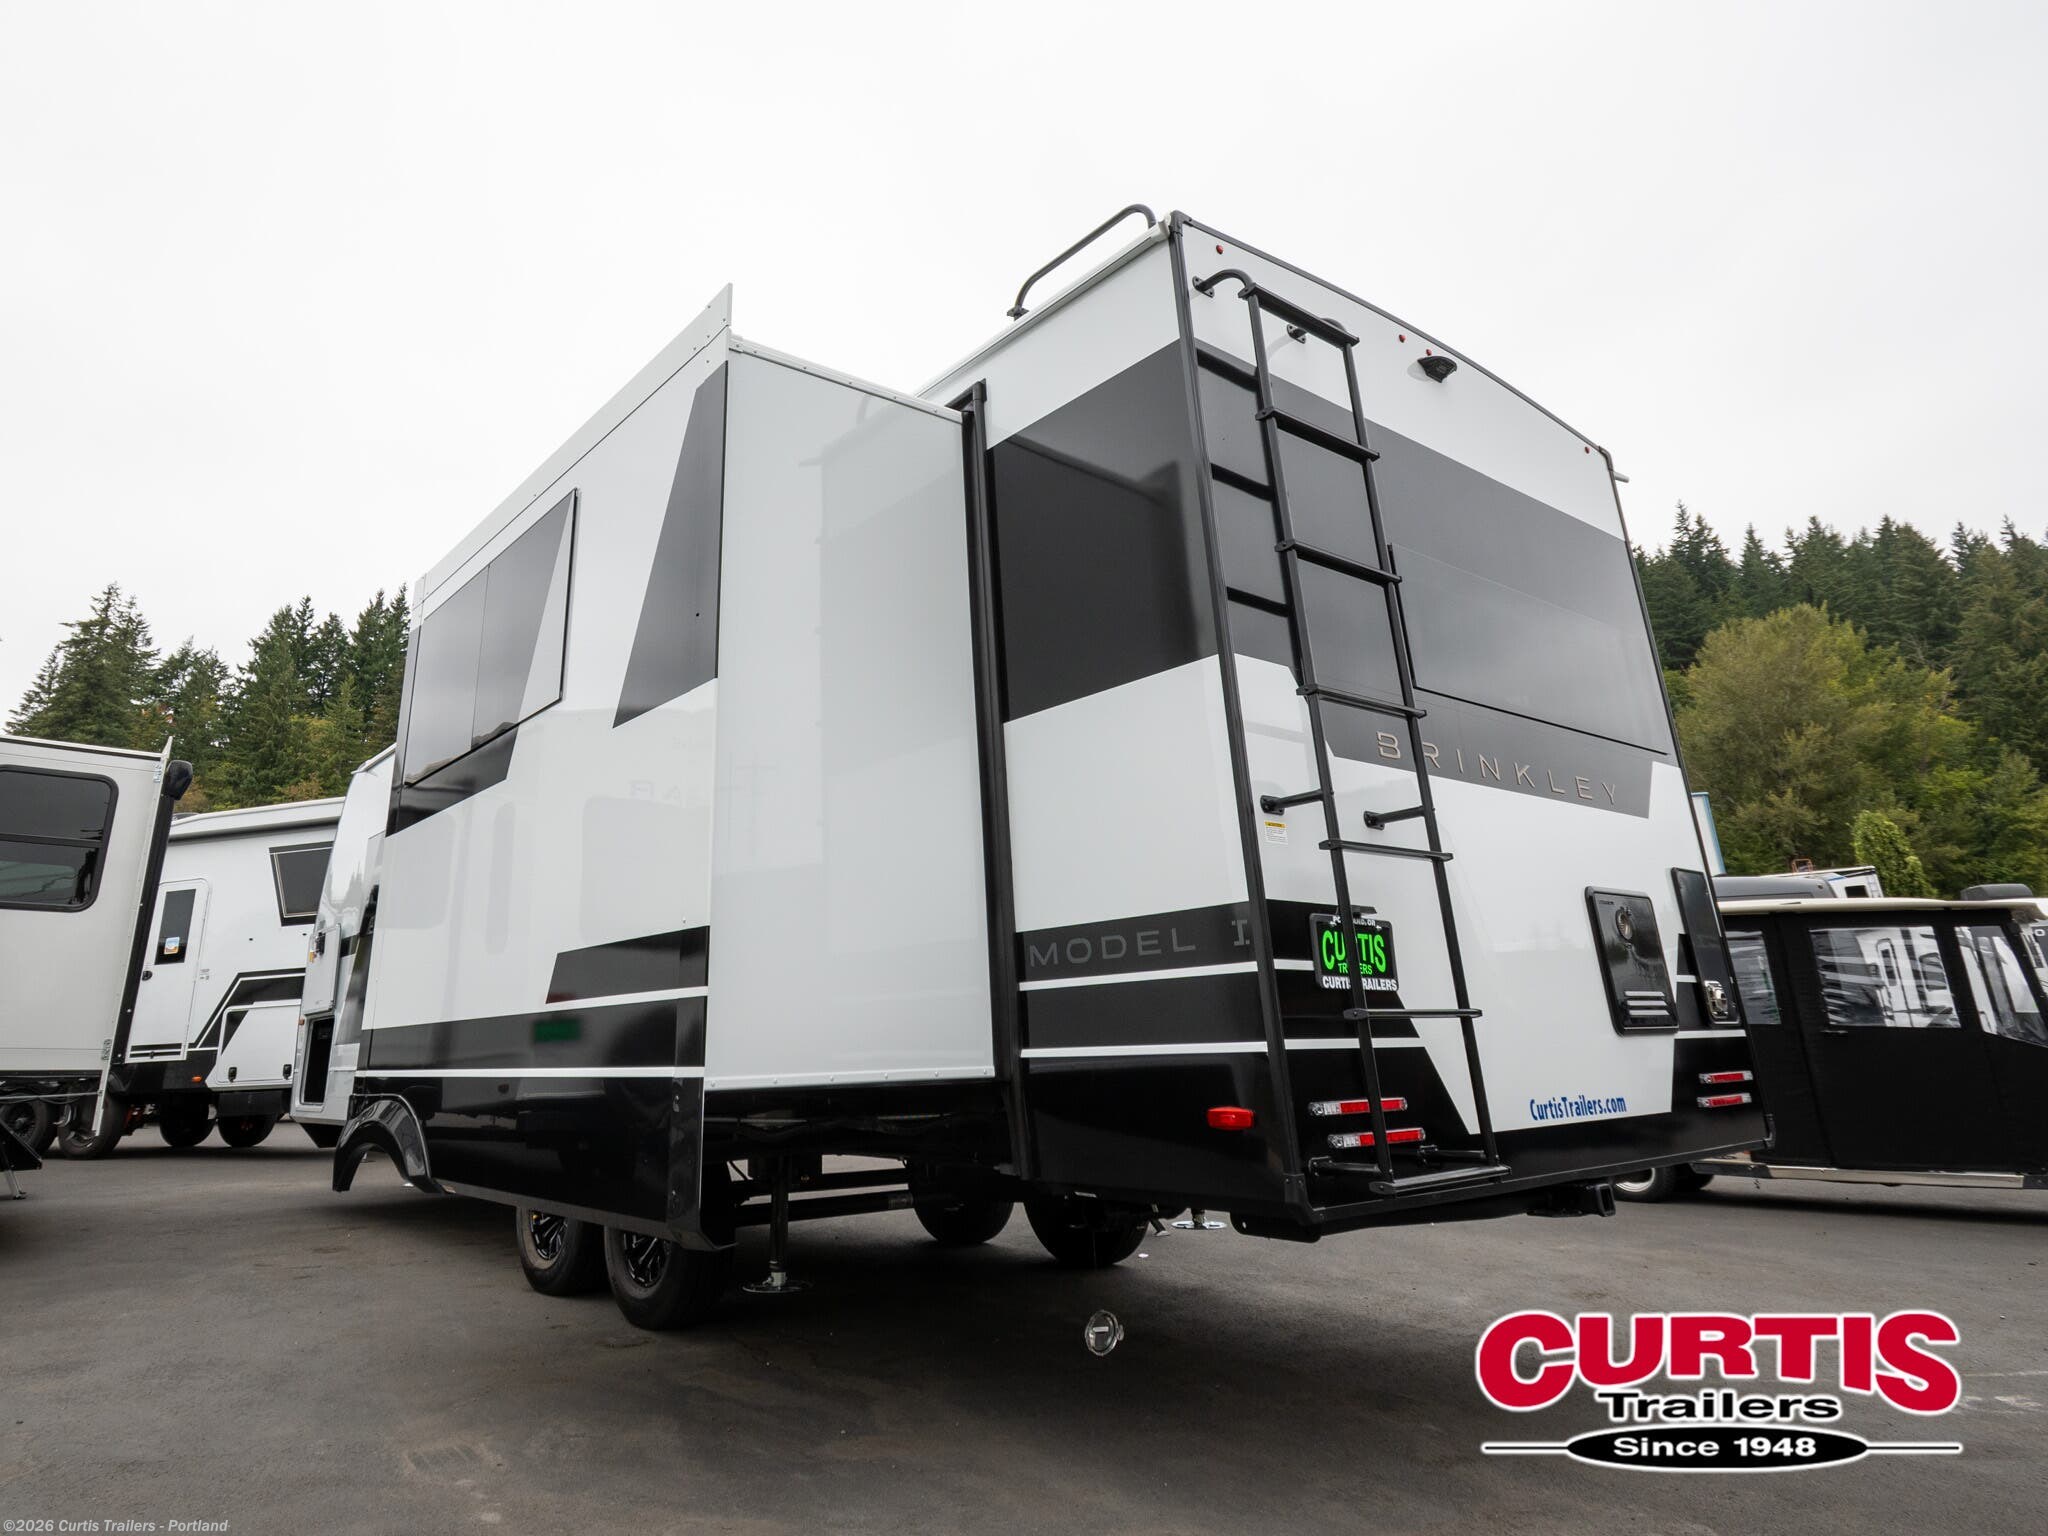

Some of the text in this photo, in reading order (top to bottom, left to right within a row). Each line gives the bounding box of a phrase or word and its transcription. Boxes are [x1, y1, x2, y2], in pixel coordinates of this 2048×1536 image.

[1376, 731, 1616, 805] BRINKLEY
[1029, 927, 1197, 967] MODEL
[1322, 929, 1387, 973] CUTIS
[1338, 962, 1373, 975] TRERS
[1361, 977, 1398, 991] RAILERS
[1529, 1094, 1627, 1121] CurtisTrailers.com
